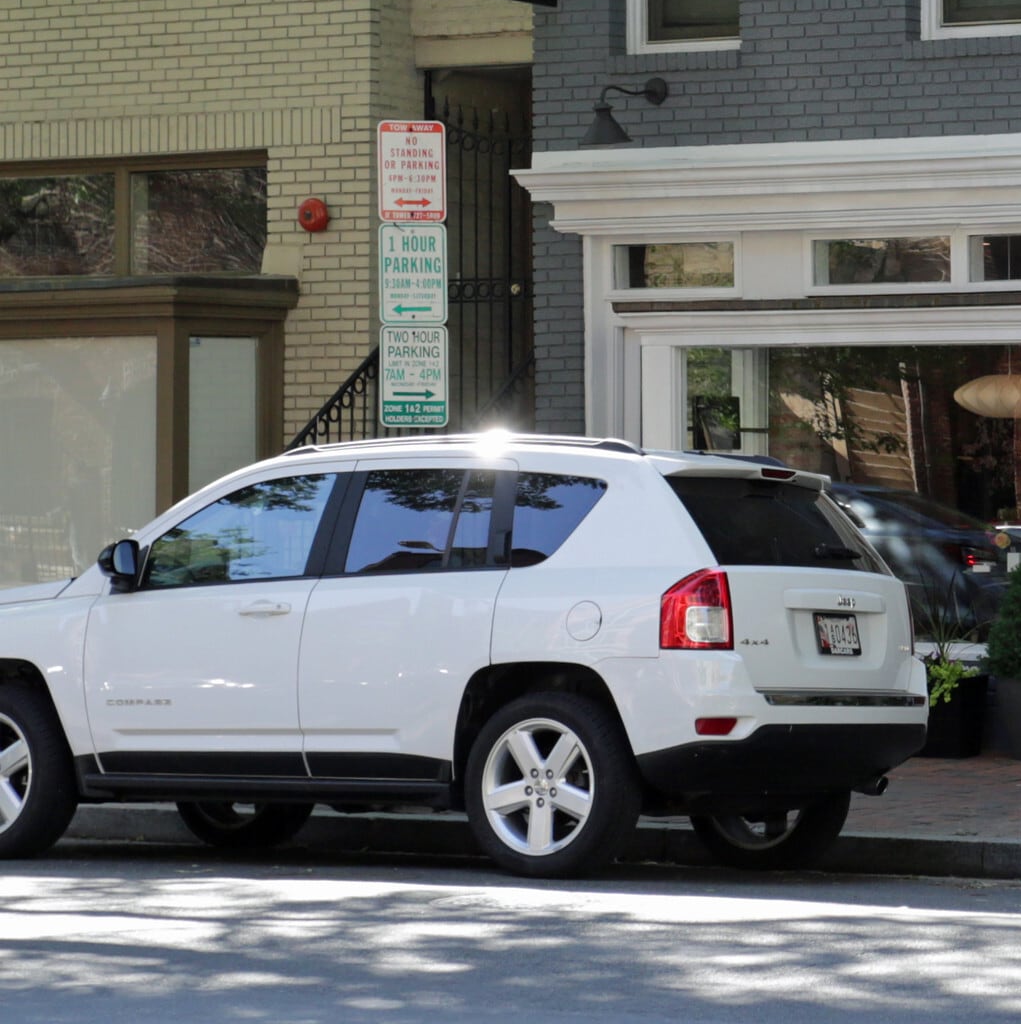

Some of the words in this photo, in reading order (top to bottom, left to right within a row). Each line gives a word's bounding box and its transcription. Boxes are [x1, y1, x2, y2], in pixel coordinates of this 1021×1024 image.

[389, 123, 407, 131] TOW
[411, 123, 434, 131] AWAY
[405, 136, 418, 145] NO
[390, 148, 433, 158] STANDING
[384, 160, 396, 170] OR
[401, 160, 440, 170] PARKING
[389, 236, 395, 252] 1
[402, 236, 436, 252] HOUR
[384, 257, 441, 273] PARKING
[387, 330, 409, 343] TWO
[412, 330, 440, 343] HOUR
[387, 346, 440, 358] PARKING
[384, 368, 405, 381] 7AM
[419, 368, 441, 381] 4PM
